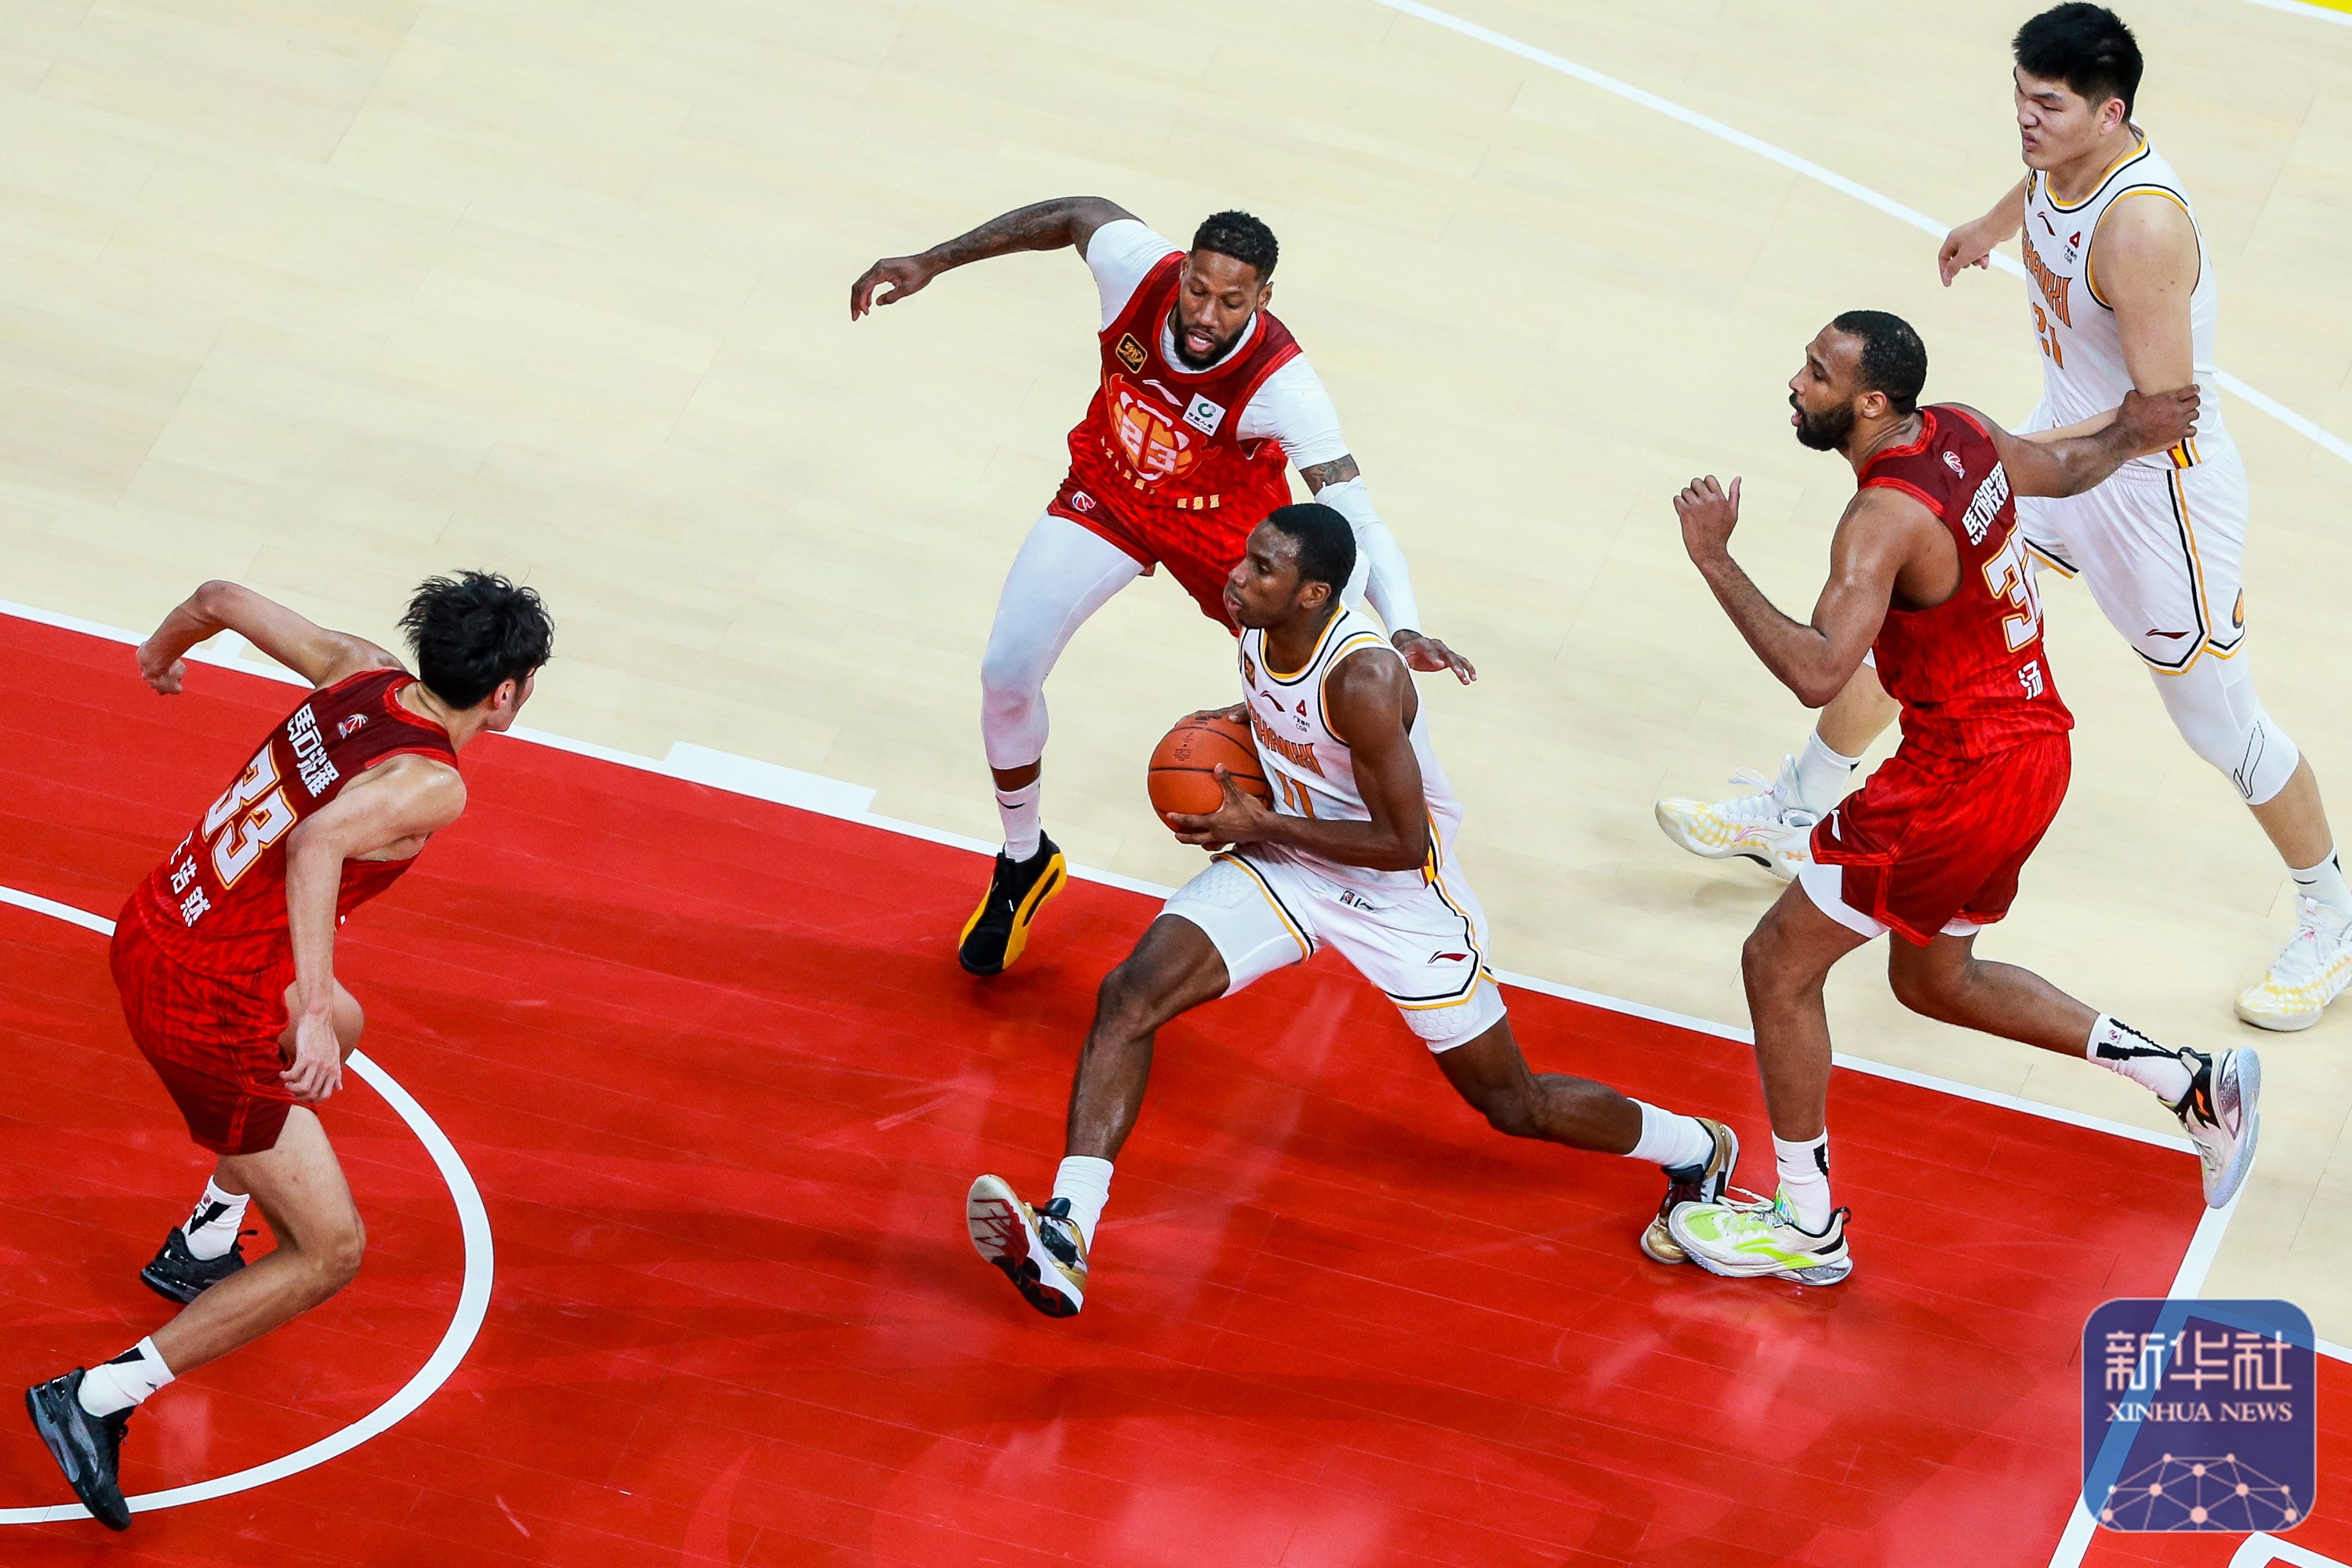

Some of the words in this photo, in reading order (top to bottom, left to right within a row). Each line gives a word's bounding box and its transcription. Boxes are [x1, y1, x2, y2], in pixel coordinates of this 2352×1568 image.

[1120, 413, 1178, 474] 23
[202, 739, 298, 891] 33
[1274, 768, 1316, 819] 11
[169, 829, 212, 927] 浩然
